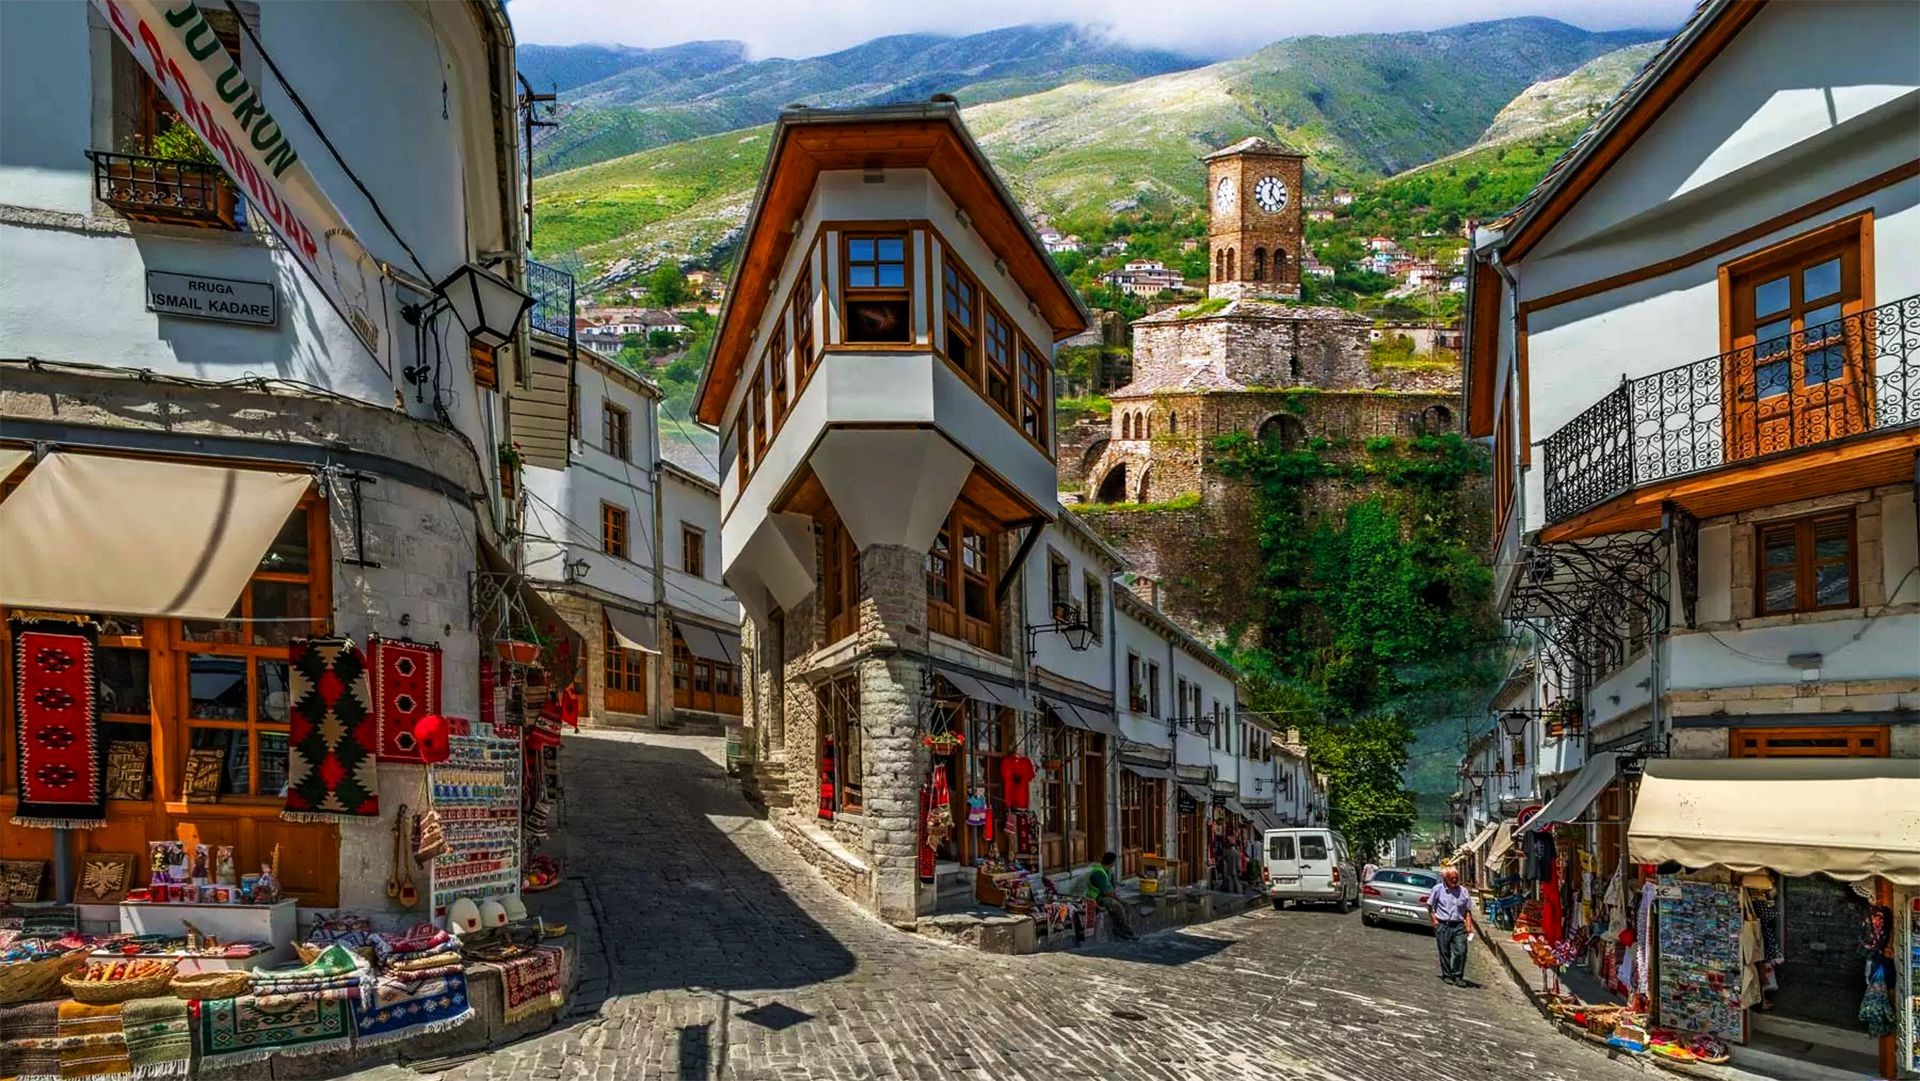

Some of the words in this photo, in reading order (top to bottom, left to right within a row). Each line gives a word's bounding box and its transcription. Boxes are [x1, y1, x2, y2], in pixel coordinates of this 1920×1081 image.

[165, 0, 219, 61] JU
[216, 63, 298, 179] URON
[188, 280, 234, 295] RRUGA
[152, 293, 202, 310] ISMAIL
[208, 300, 270, 317] KADARE
